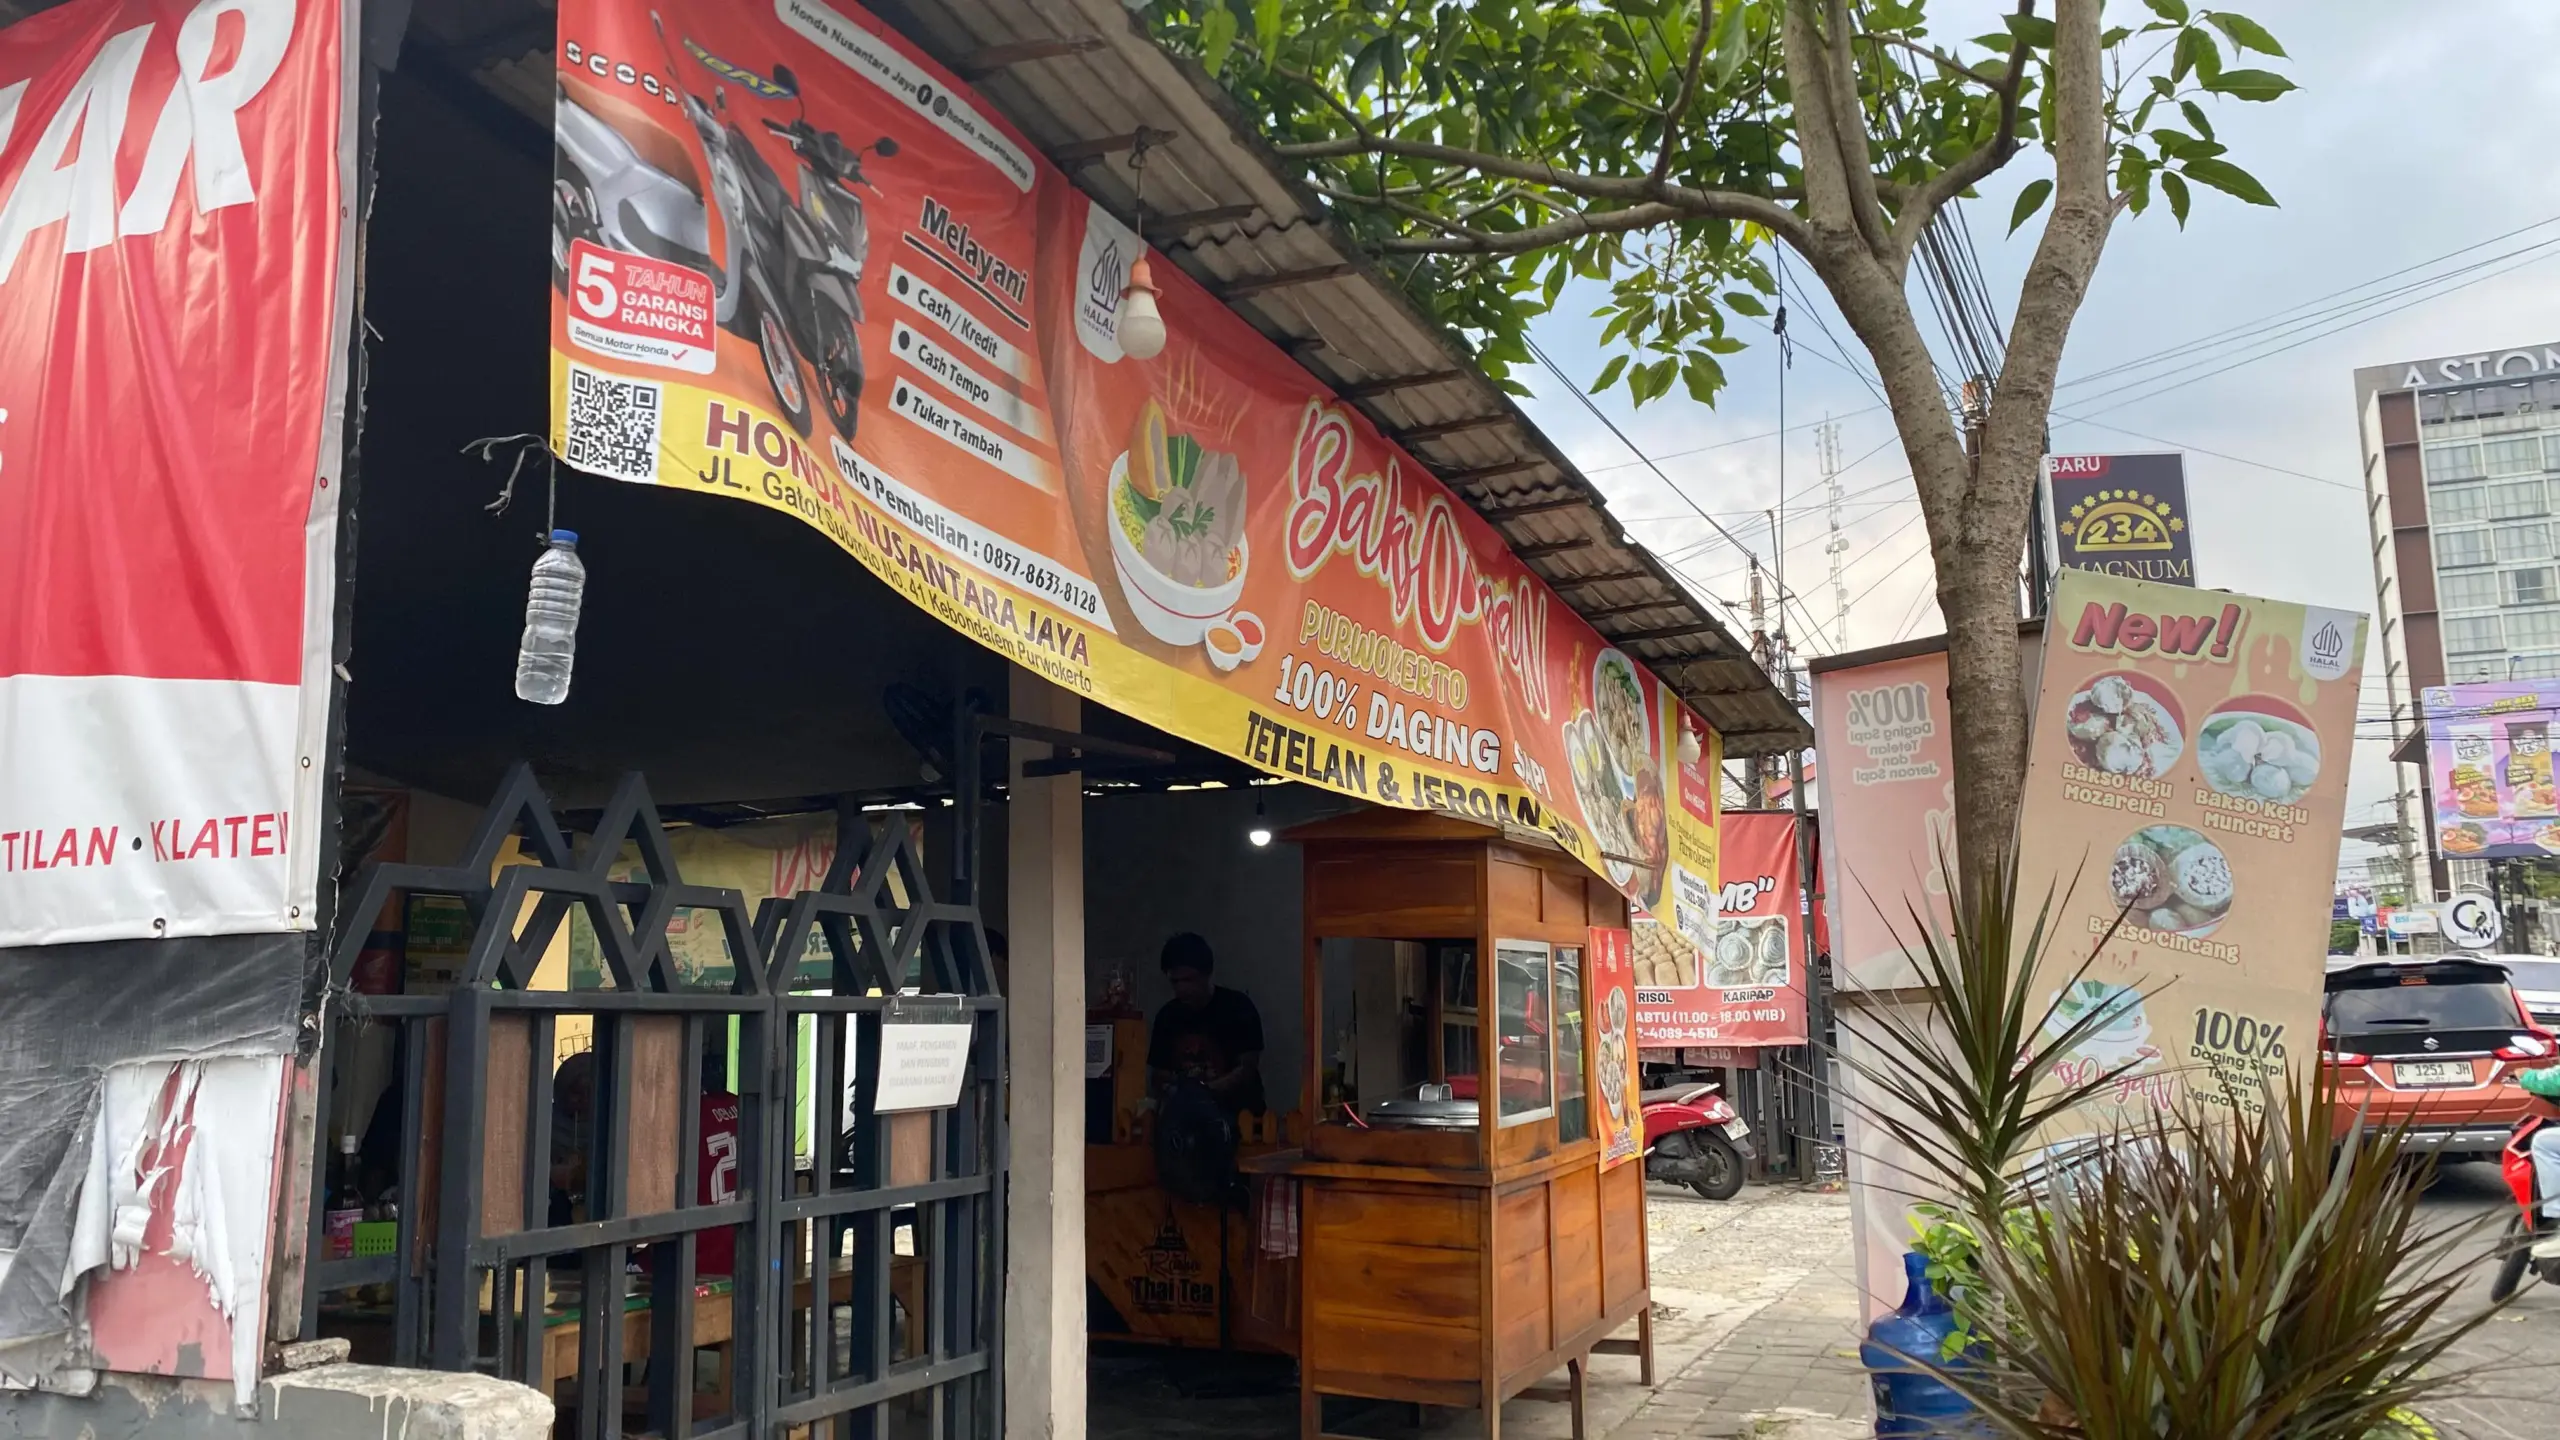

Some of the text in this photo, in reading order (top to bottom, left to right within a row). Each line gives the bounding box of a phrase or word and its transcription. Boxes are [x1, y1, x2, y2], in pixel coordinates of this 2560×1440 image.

[790, 0, 917, 95] Honda Nusantara Jaya
[920, 195, 1028, 305] Melayani
[576, 252, 618, 319] 5
[622, 290, 708, 321] GARANSI
[624, 264, 708, 304] TAHUN
[575, 326, 604, 343] Semua
[605, 337, 634, 350] Motor
[635, 343, 669, 356] Honda
[621, 307, 704, 339] RANGKA
[917, 287, 952, 324] Cash
[960, 316, 998, 358] Kredit
[1084, 303, 1114, 334] HALAL
[917, 344, 989, 403] Cash Tempo
[913, 395, 1003, 462] Tukar Tambah
[2050, 456, 2101, 473] BARU
[835, 444, 871, 491] Info
[873, 475, 968, 552] Pembelian
[705, 401, 1090, 667] HONDA NUSANTARA JAYA
[2087, 514, 2158, 544] 234
[699, 455, 1092, 693] JL. Gatot Subroto No. 41 Kebondalem Purwokerto
[1299, 599, 1468, 711] PURWOKERTO
[2071, 601, 2242, 658] New!
[2309, 656, 2341, 668] HALAL
[1274, 653, 1553, 802] 100% DAGING SAPI
[1244, 710, 1368, 795] TETELAN
[1377, 761, 1403, 804] &
[1411, 771, 1541, 827] JEROAN
[2, 826, 119, 872] TILAN
[1637, 992, 1673, 1003] RISOL
[1723, 989, 1775, 1002] KARIPAP
[2194, 1007, 2285, 1059] 100%
[2190, 1045, 2284, 1077] Daging Spi
[2397, 1063, 2471, 1077] R 1251 JH
